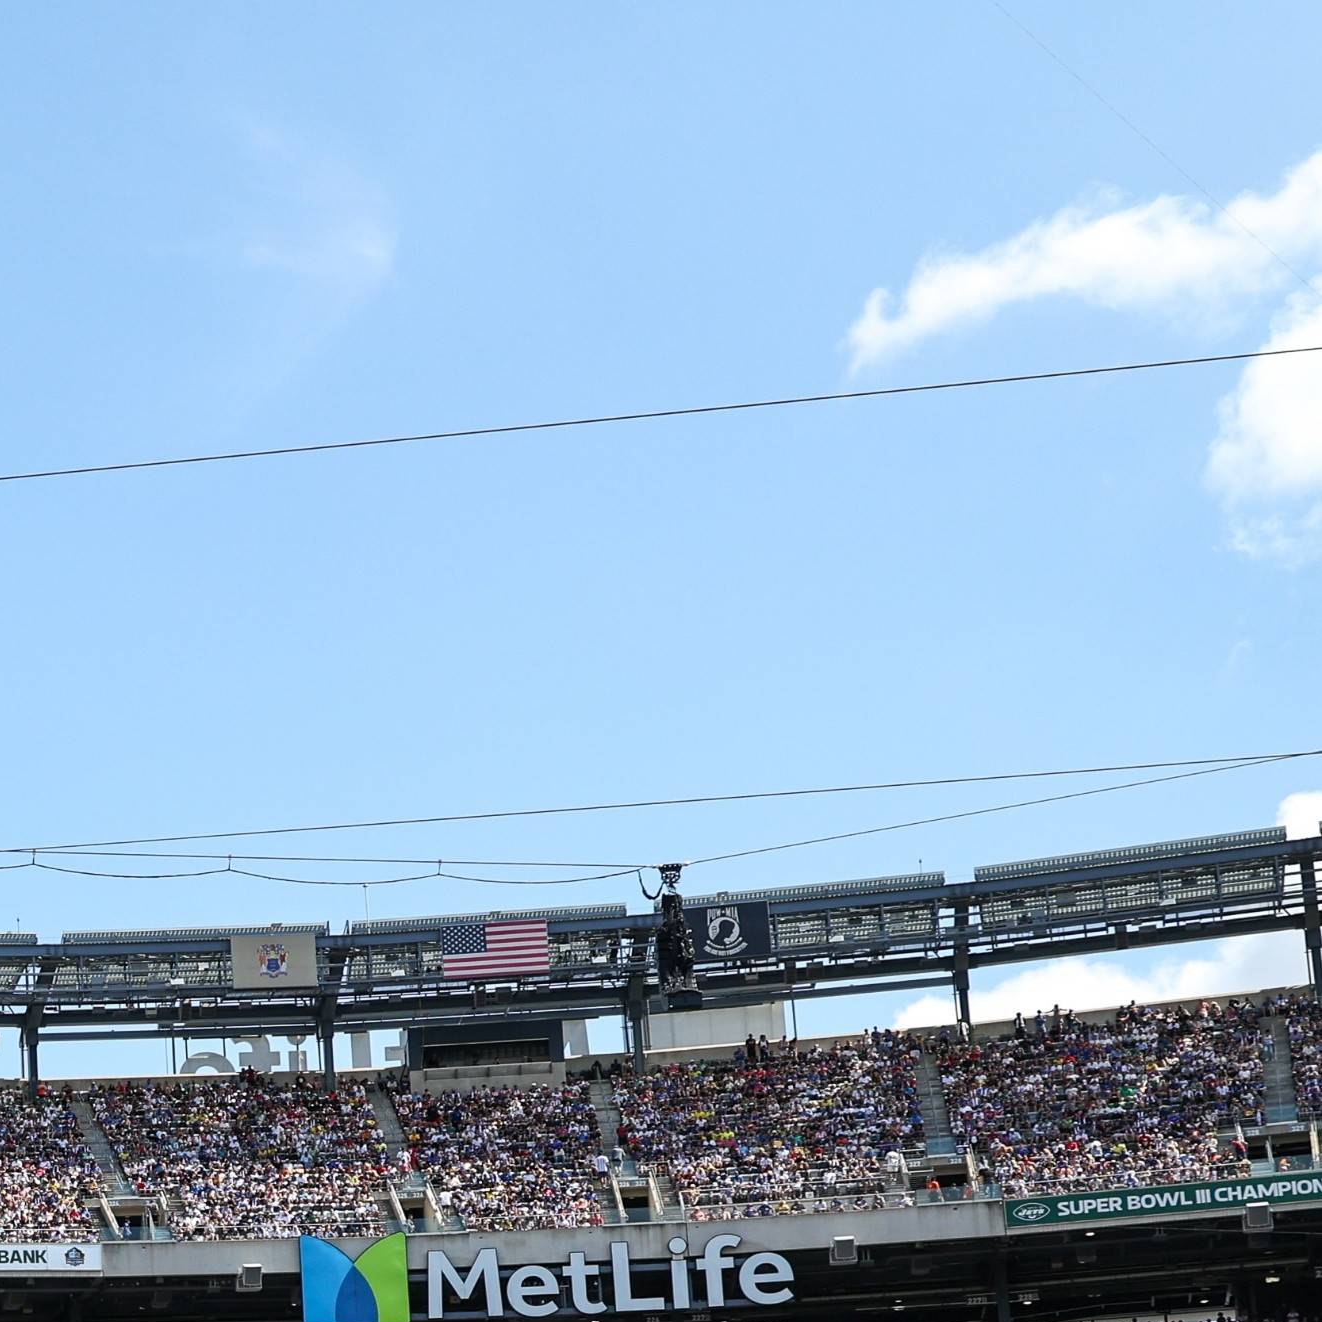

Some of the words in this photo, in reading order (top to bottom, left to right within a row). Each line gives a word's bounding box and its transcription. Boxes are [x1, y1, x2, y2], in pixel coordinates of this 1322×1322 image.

[1057, 1197, 1126, 1217] SUPER
[1131, 1192, 1193, 1210] BOWL
[1196, 1188, 1211, 1205] III
[427, 1233, 795, 1320] MetLife
